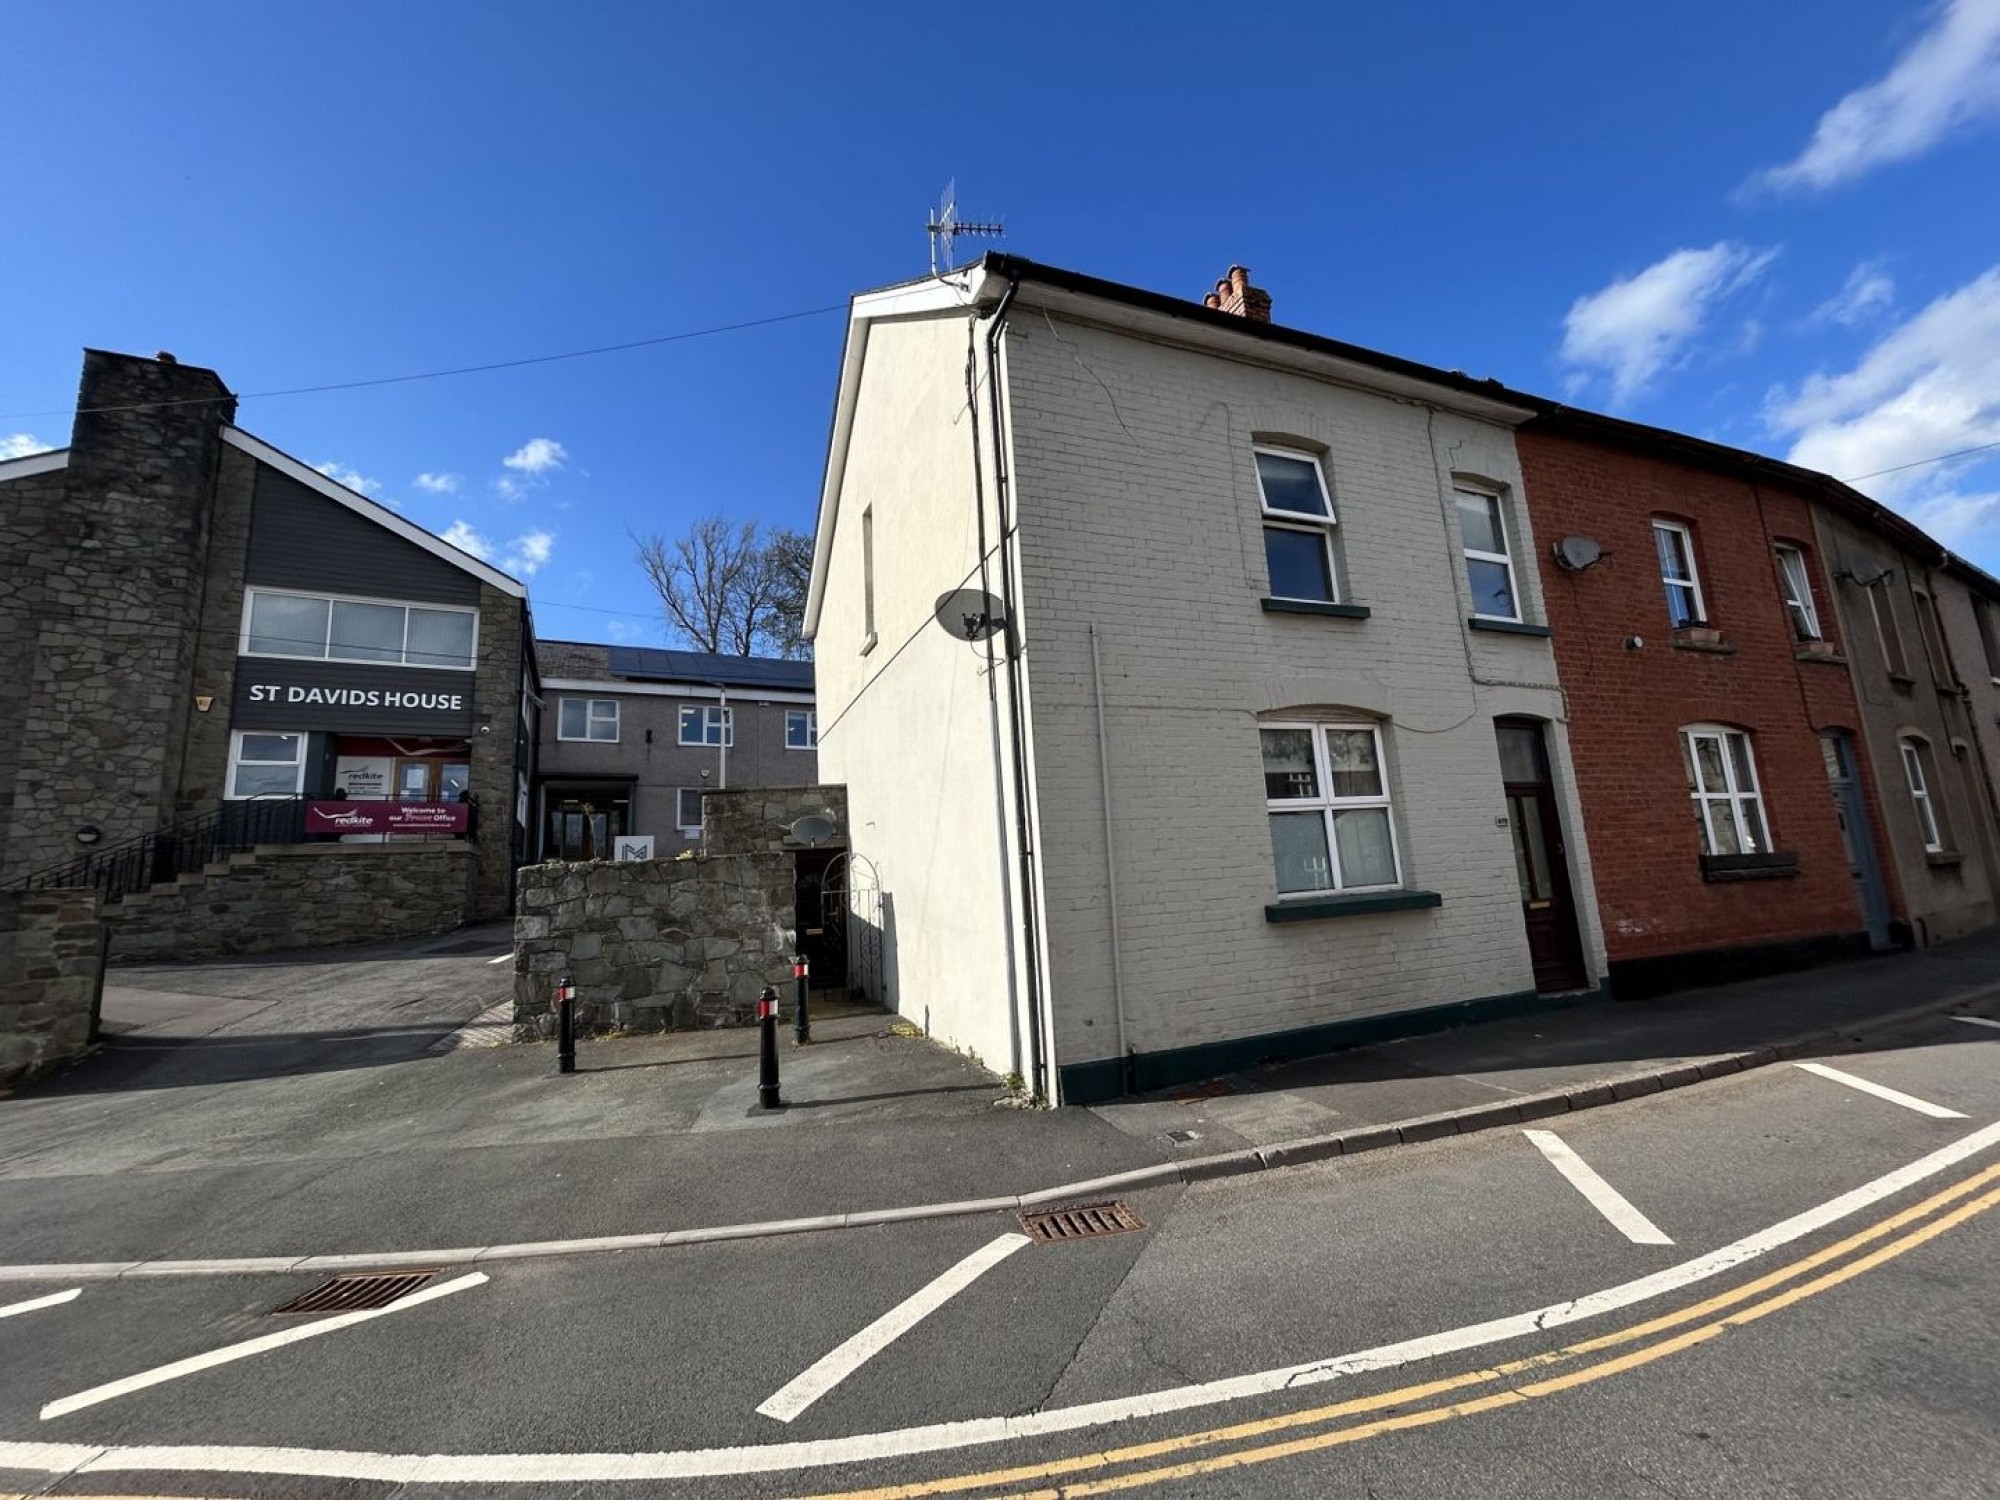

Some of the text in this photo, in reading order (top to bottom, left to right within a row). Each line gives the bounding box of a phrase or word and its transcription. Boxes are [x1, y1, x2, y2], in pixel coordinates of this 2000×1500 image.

[249, 684, 462, 710] ST DAVIDS HOUSE
